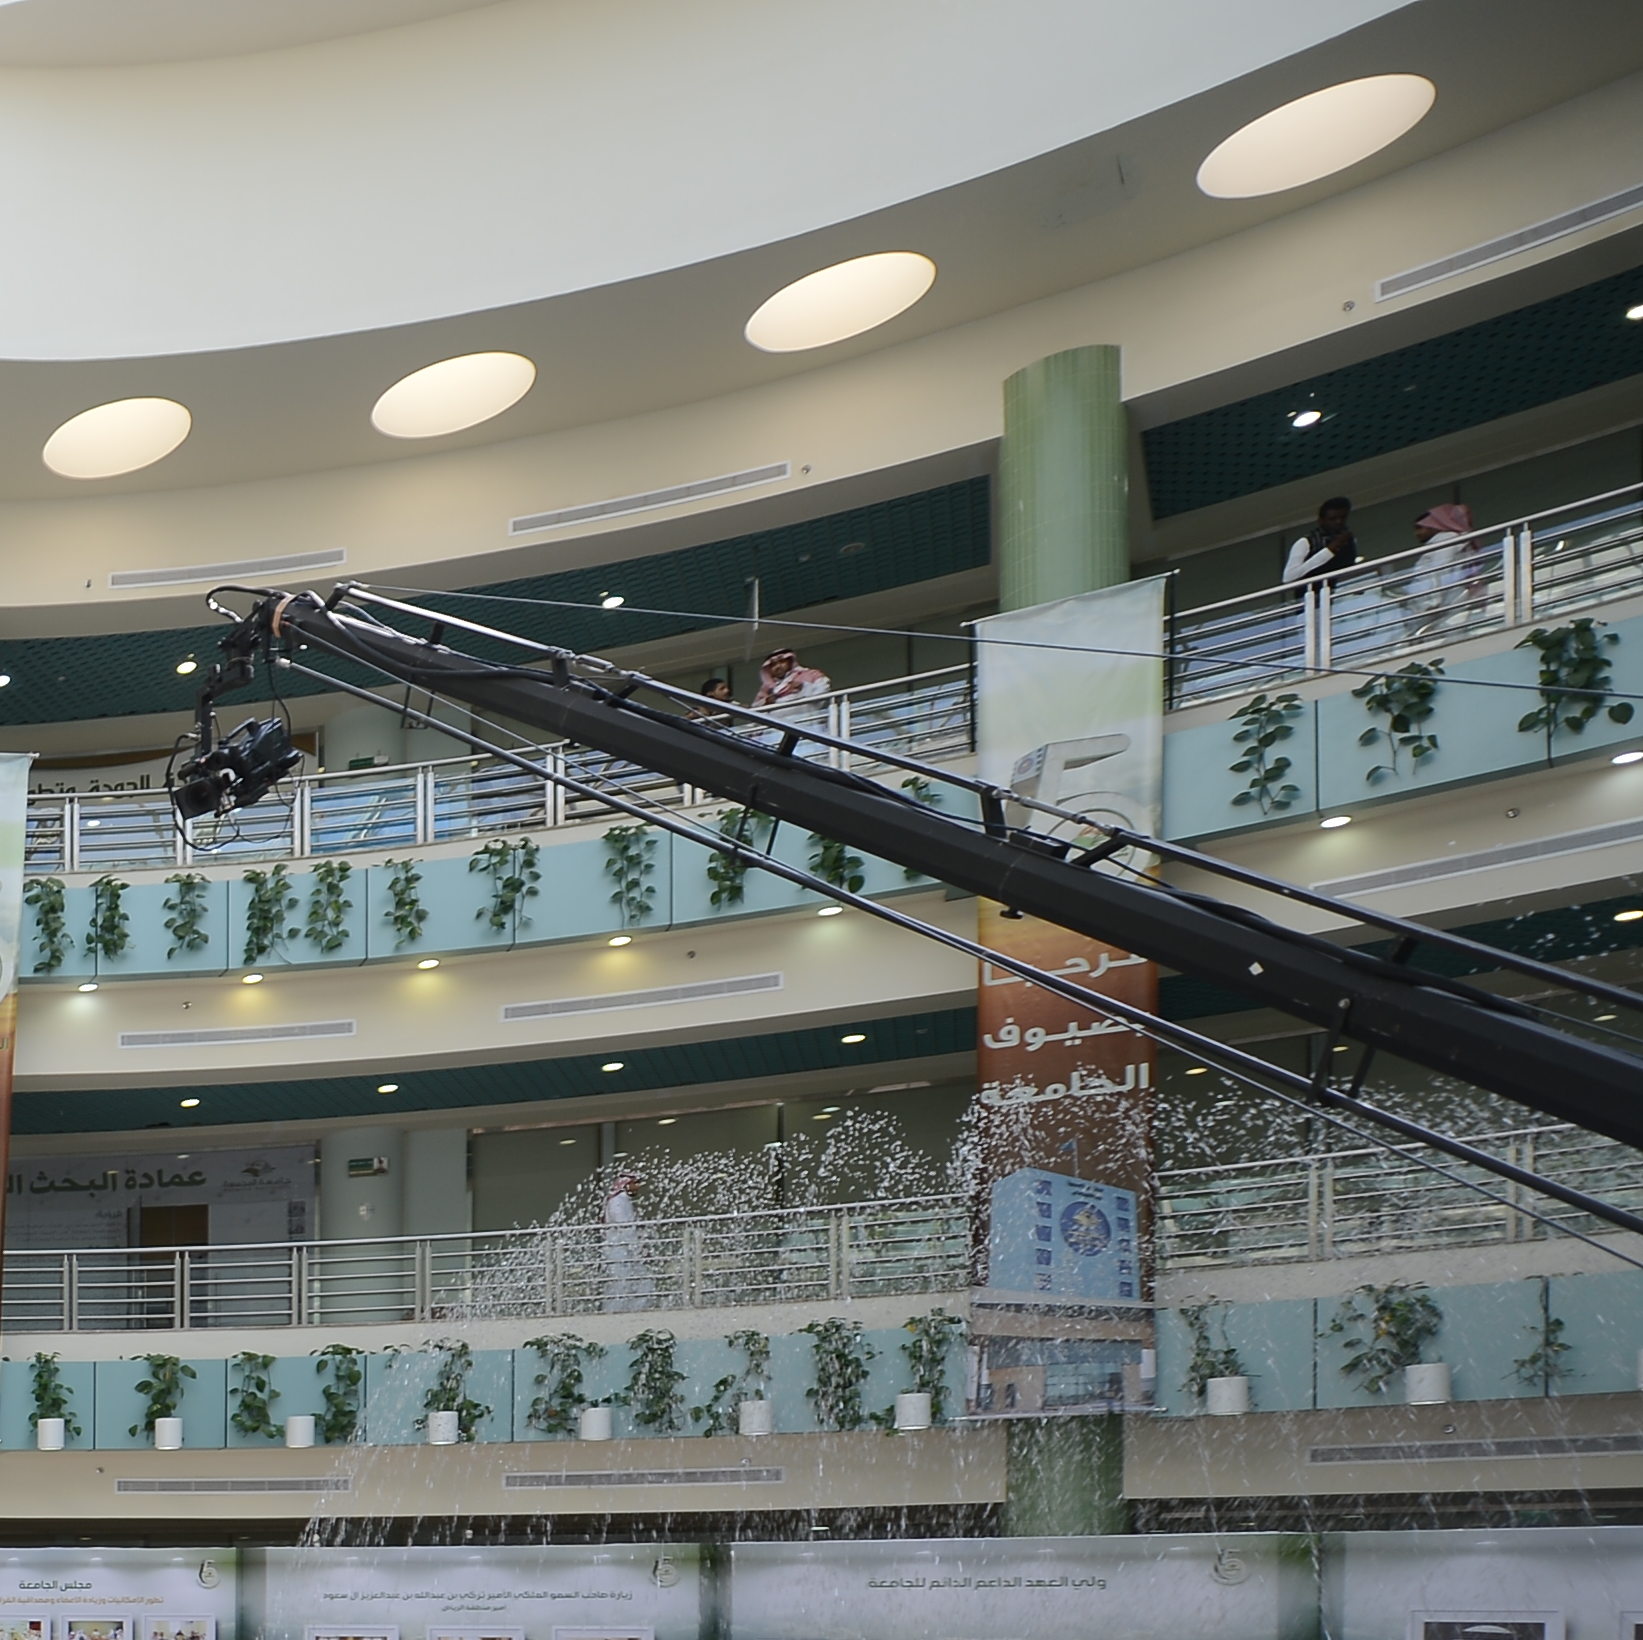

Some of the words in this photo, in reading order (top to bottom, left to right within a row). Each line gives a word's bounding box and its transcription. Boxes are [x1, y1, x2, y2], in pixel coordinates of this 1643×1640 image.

[30, 1169, 118, 1195] البحث
[125, 1167, 207, 1189] عمادة
[19, 1580, 59, 1591] الجامعة
[60, 1580, 92, 1591] مجلس
[867, 1575, 926, 1589] للجامعة
[974, 1576, 1022, 1589] الداعم
[1025, 1576, 1068, 1588] العهد
[1073, 1576, 1107, 1590] ولي
